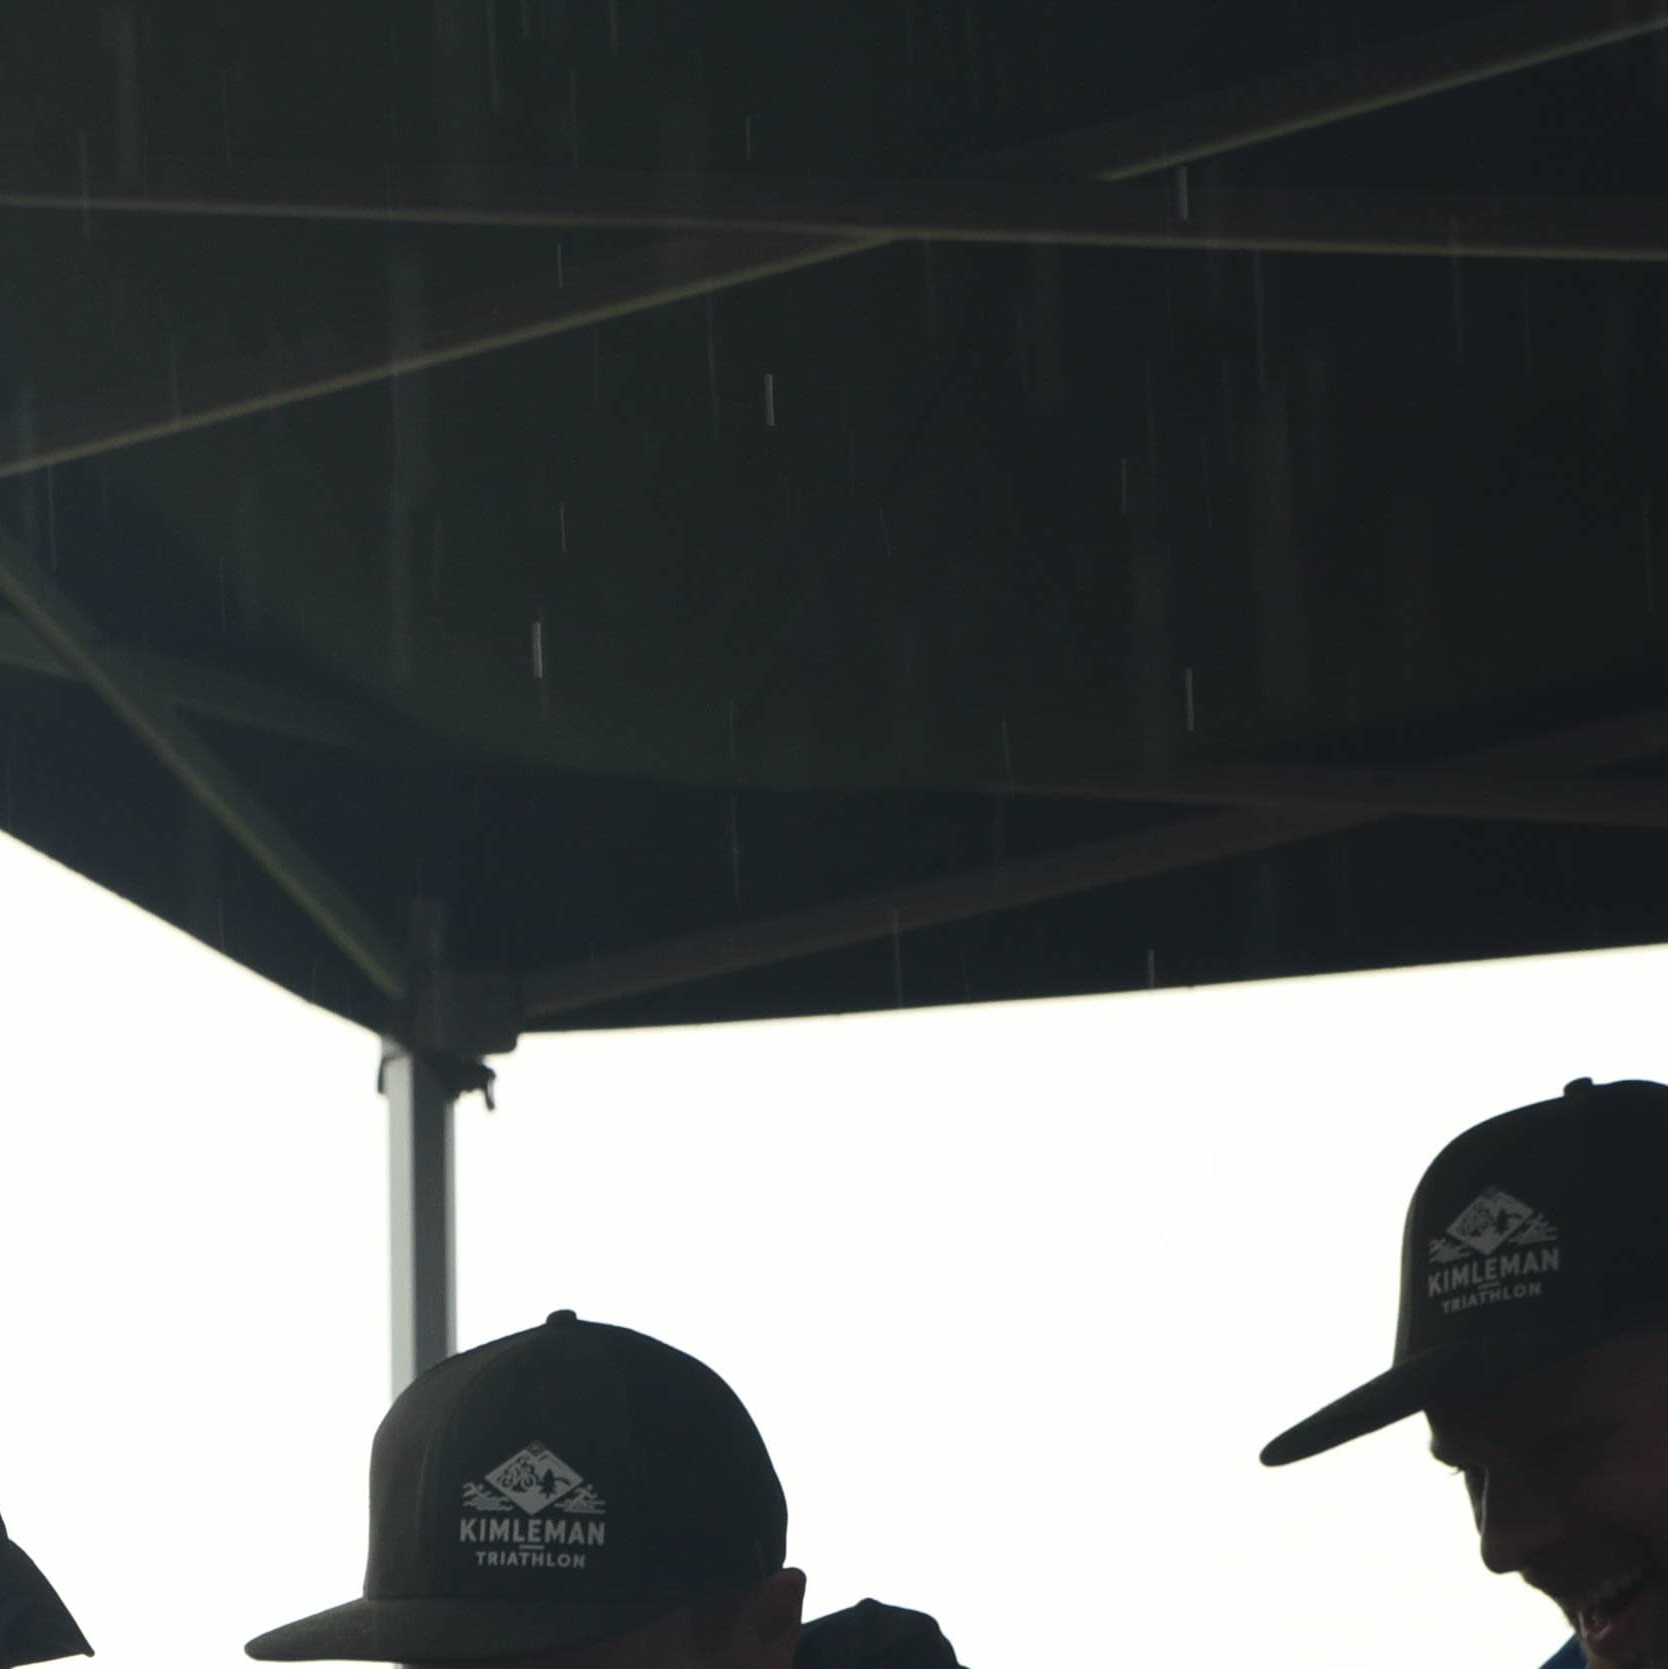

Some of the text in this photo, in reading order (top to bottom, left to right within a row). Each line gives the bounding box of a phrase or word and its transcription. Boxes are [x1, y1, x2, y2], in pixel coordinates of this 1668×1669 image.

[1429, 1249, 1559, 1297] KIMLEMAN
[1444, 1283, 1541, 1313] TRIATHLON
[460, 1519, 605, 1546] KIMLEMAN
[476, 1551, 585, 1568] TRIATHLON
